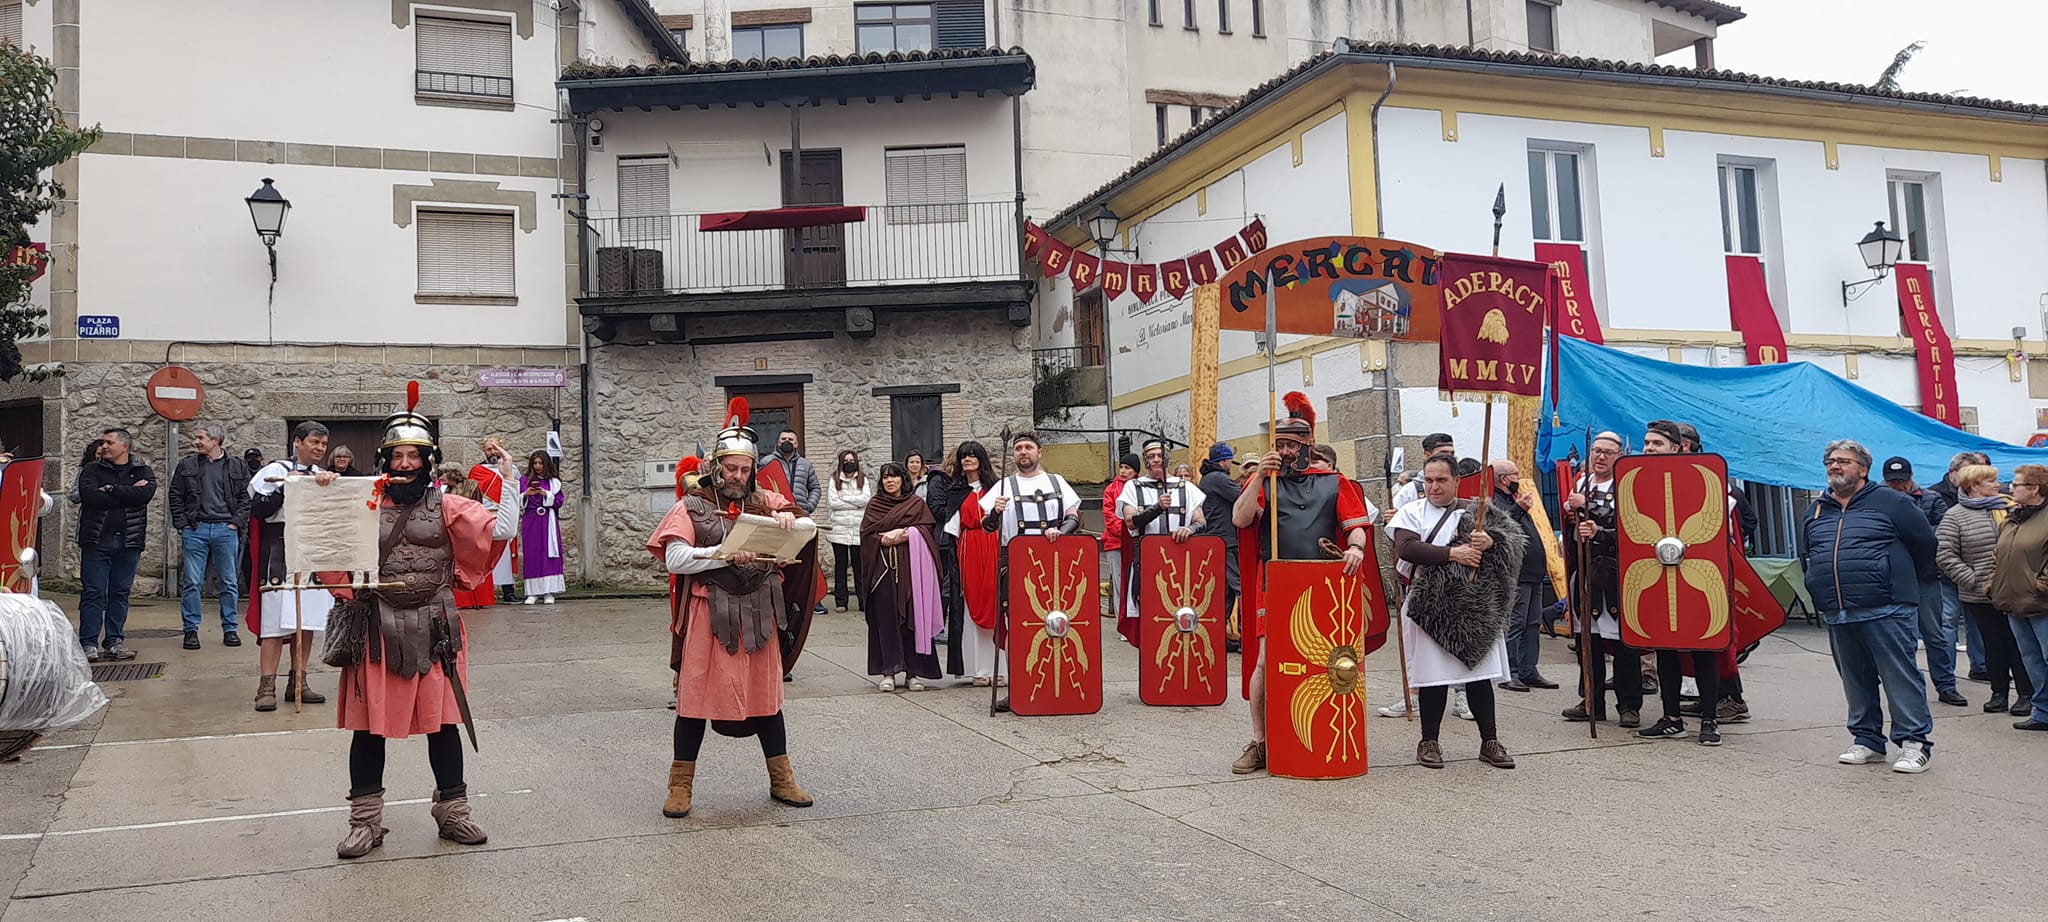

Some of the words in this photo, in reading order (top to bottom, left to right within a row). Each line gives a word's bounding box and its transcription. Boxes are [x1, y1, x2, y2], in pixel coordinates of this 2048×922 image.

[1443, 271, 1544, 314] ADEPACT
[1555, 260, 1585, 340] MERC
[80, 326, 118, 335] PIZARRO
[1906, 277, 1946, 420] MERCATUM
